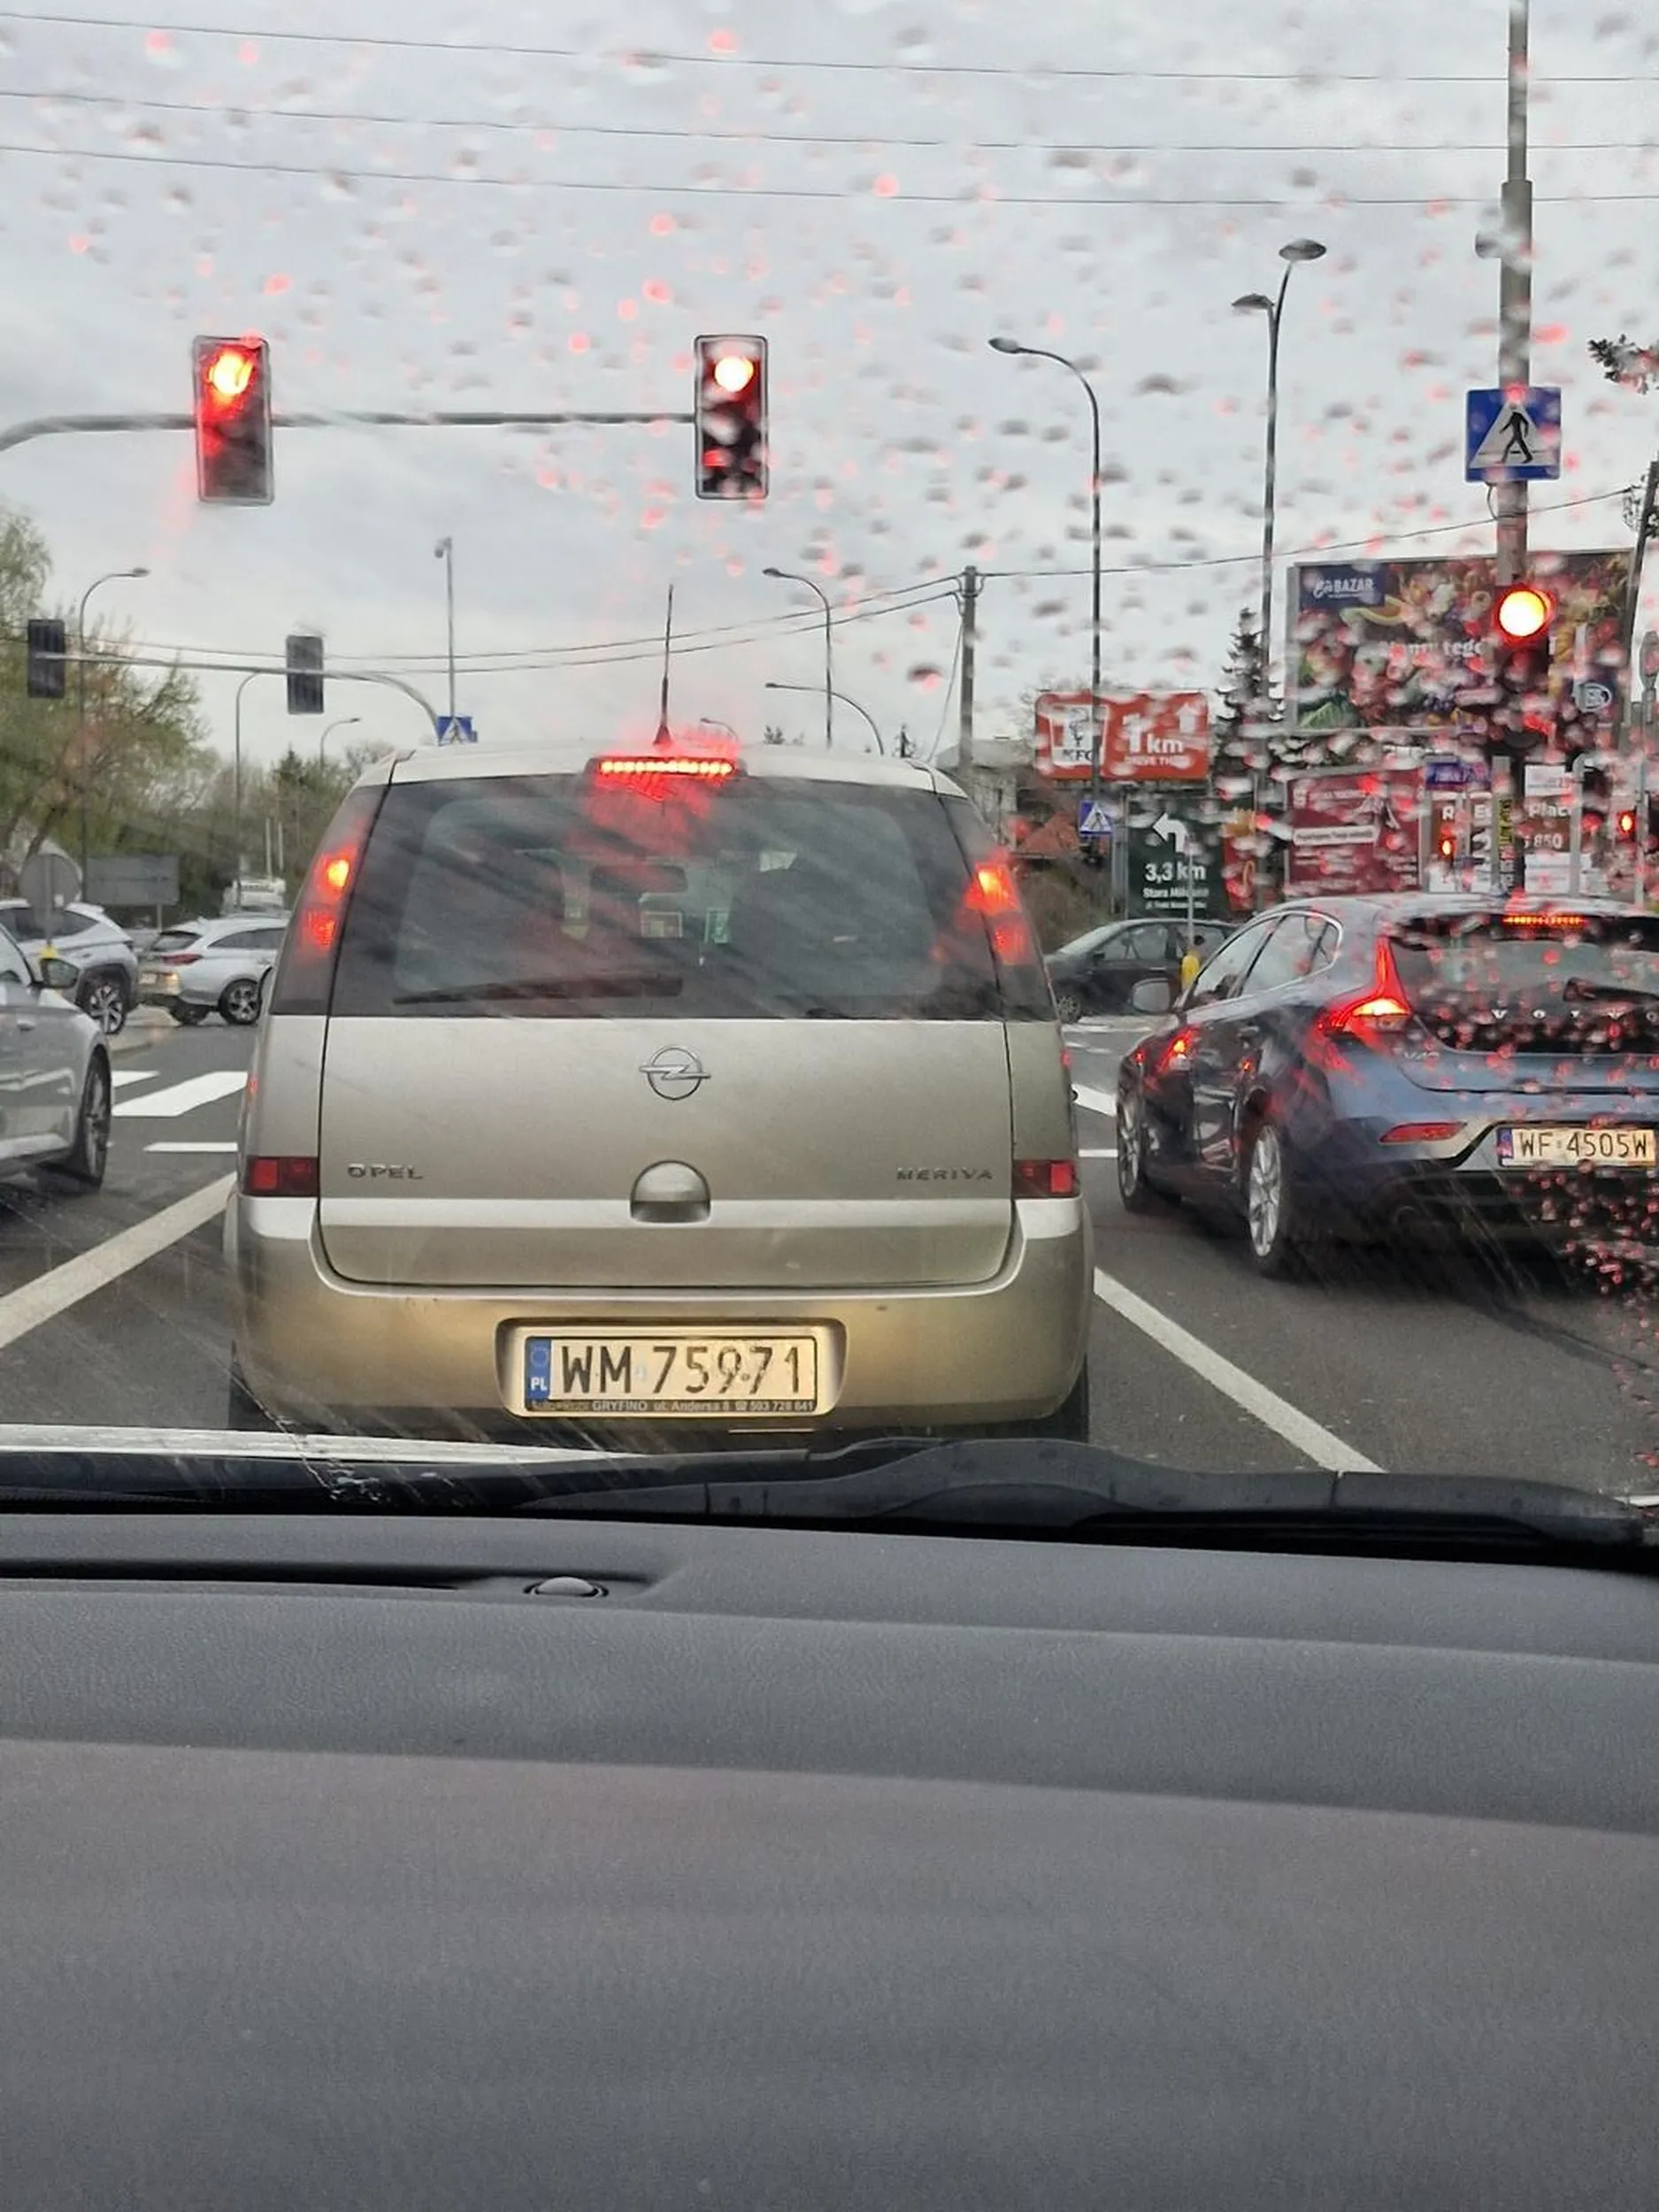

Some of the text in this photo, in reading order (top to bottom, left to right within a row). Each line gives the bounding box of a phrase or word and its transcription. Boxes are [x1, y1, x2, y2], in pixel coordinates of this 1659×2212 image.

[1334, 577, 1374, 592] BAZAR
[1148, 733, 1184, 753] km
[1145, 861, 1206, 884] 3,3 km
[1520, 1131, 1647, 1158] WF 4505W
[347, 1163, 423, 1179] OPEL
[896, 1167, 995, 1180] MERIVA
[562, 1346, 799, 1394] WM 75971
[531, 1377, 548, 1392] PL
[592, 1401, 648, 1411] GRYFINO
